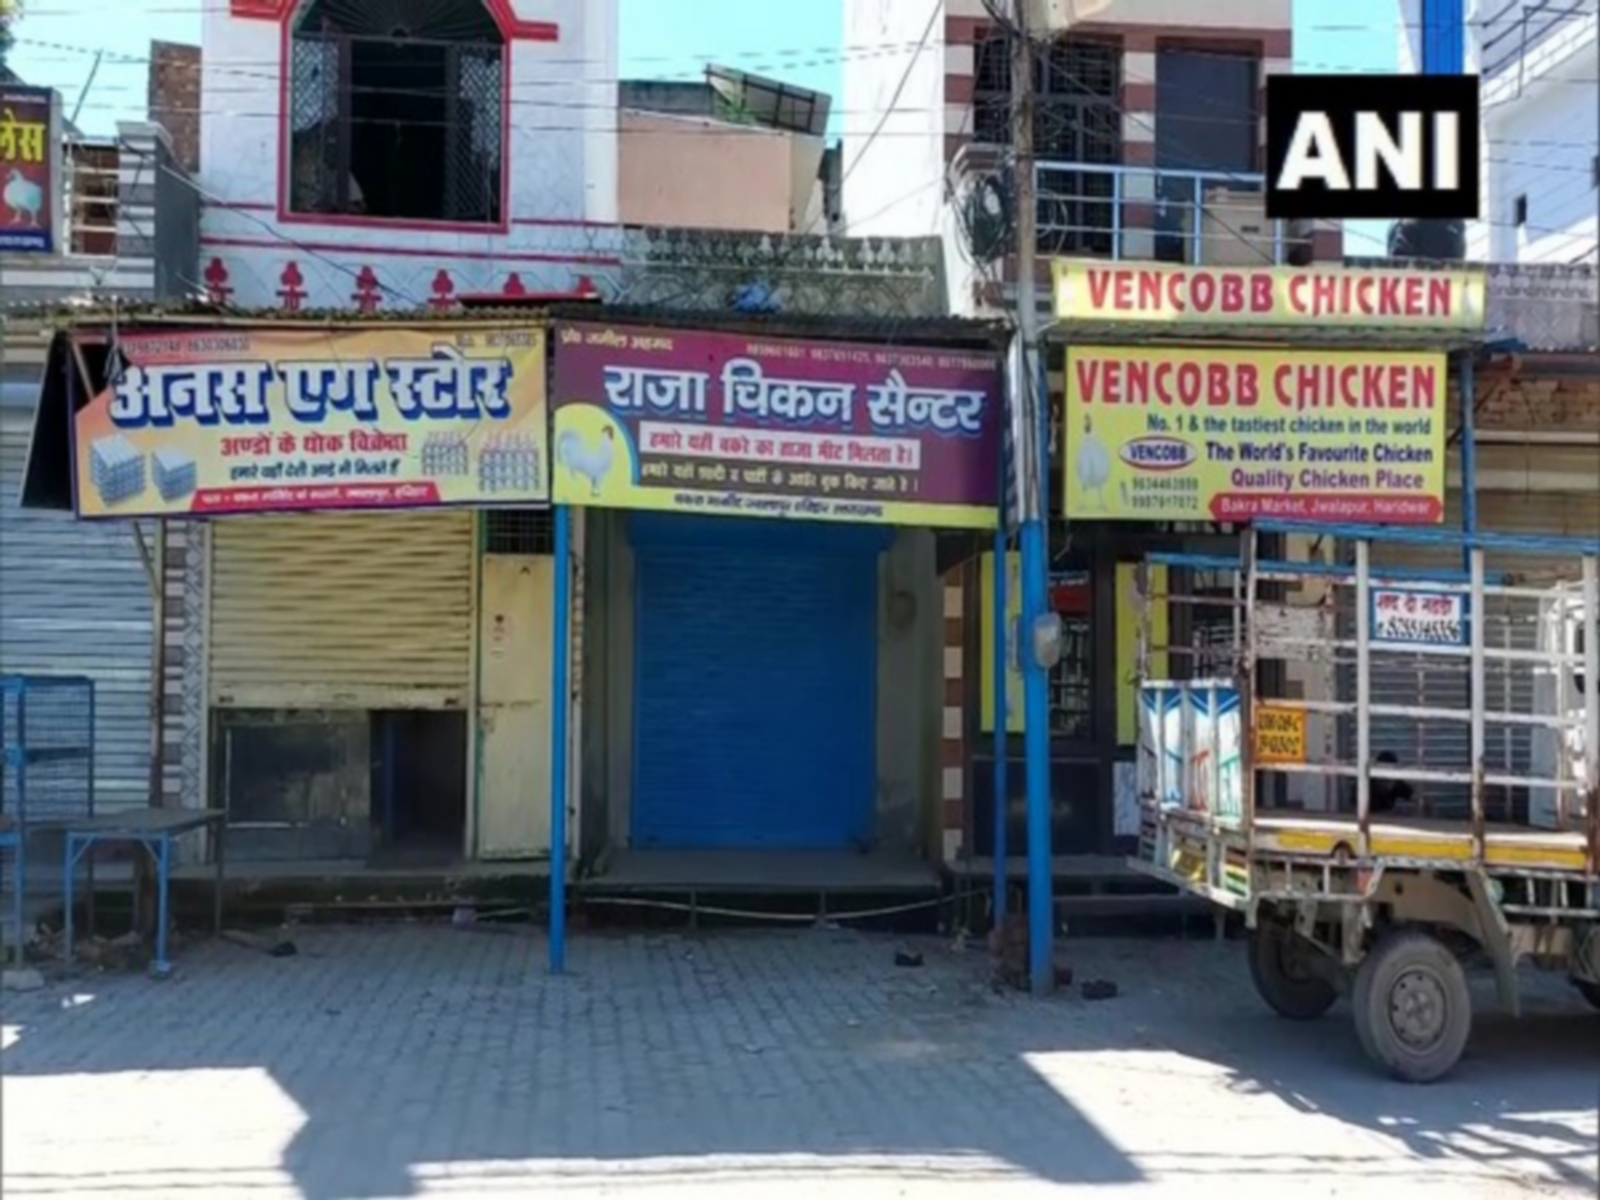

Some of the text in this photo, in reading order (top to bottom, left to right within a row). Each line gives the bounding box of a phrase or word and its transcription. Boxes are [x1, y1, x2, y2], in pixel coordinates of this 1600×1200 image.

[1087, 269, 1452, 317] VENCOBB CHICKEN
[109, 341, 513, 428] अनस एग स्टोर
[604, 358, 987, 434] राजा चिकन सैन्टर
[1076, 359, 1436, 411] VENCOBB CHICKEN
[1147, 413, 1431, 435] No. 1 & the tastiest chicken in the world
[278, 432, 296, 454] के
[303, 434, 344, 454] थोक
[649, 427, 683, 450] हमारे
[756, 438, 774, 456] का
[817, 439, 844, 461] मीट
[848, 439, 893, 463] मिलता
[1129, 445, 1188, 461] VENCOBB
[1206, 441, 1433, 463] The World's Favourite Chicken
[1231, 468, 1425, 491] Quality Chicken Place
[1221, 497, 1257, 514] Bakra
